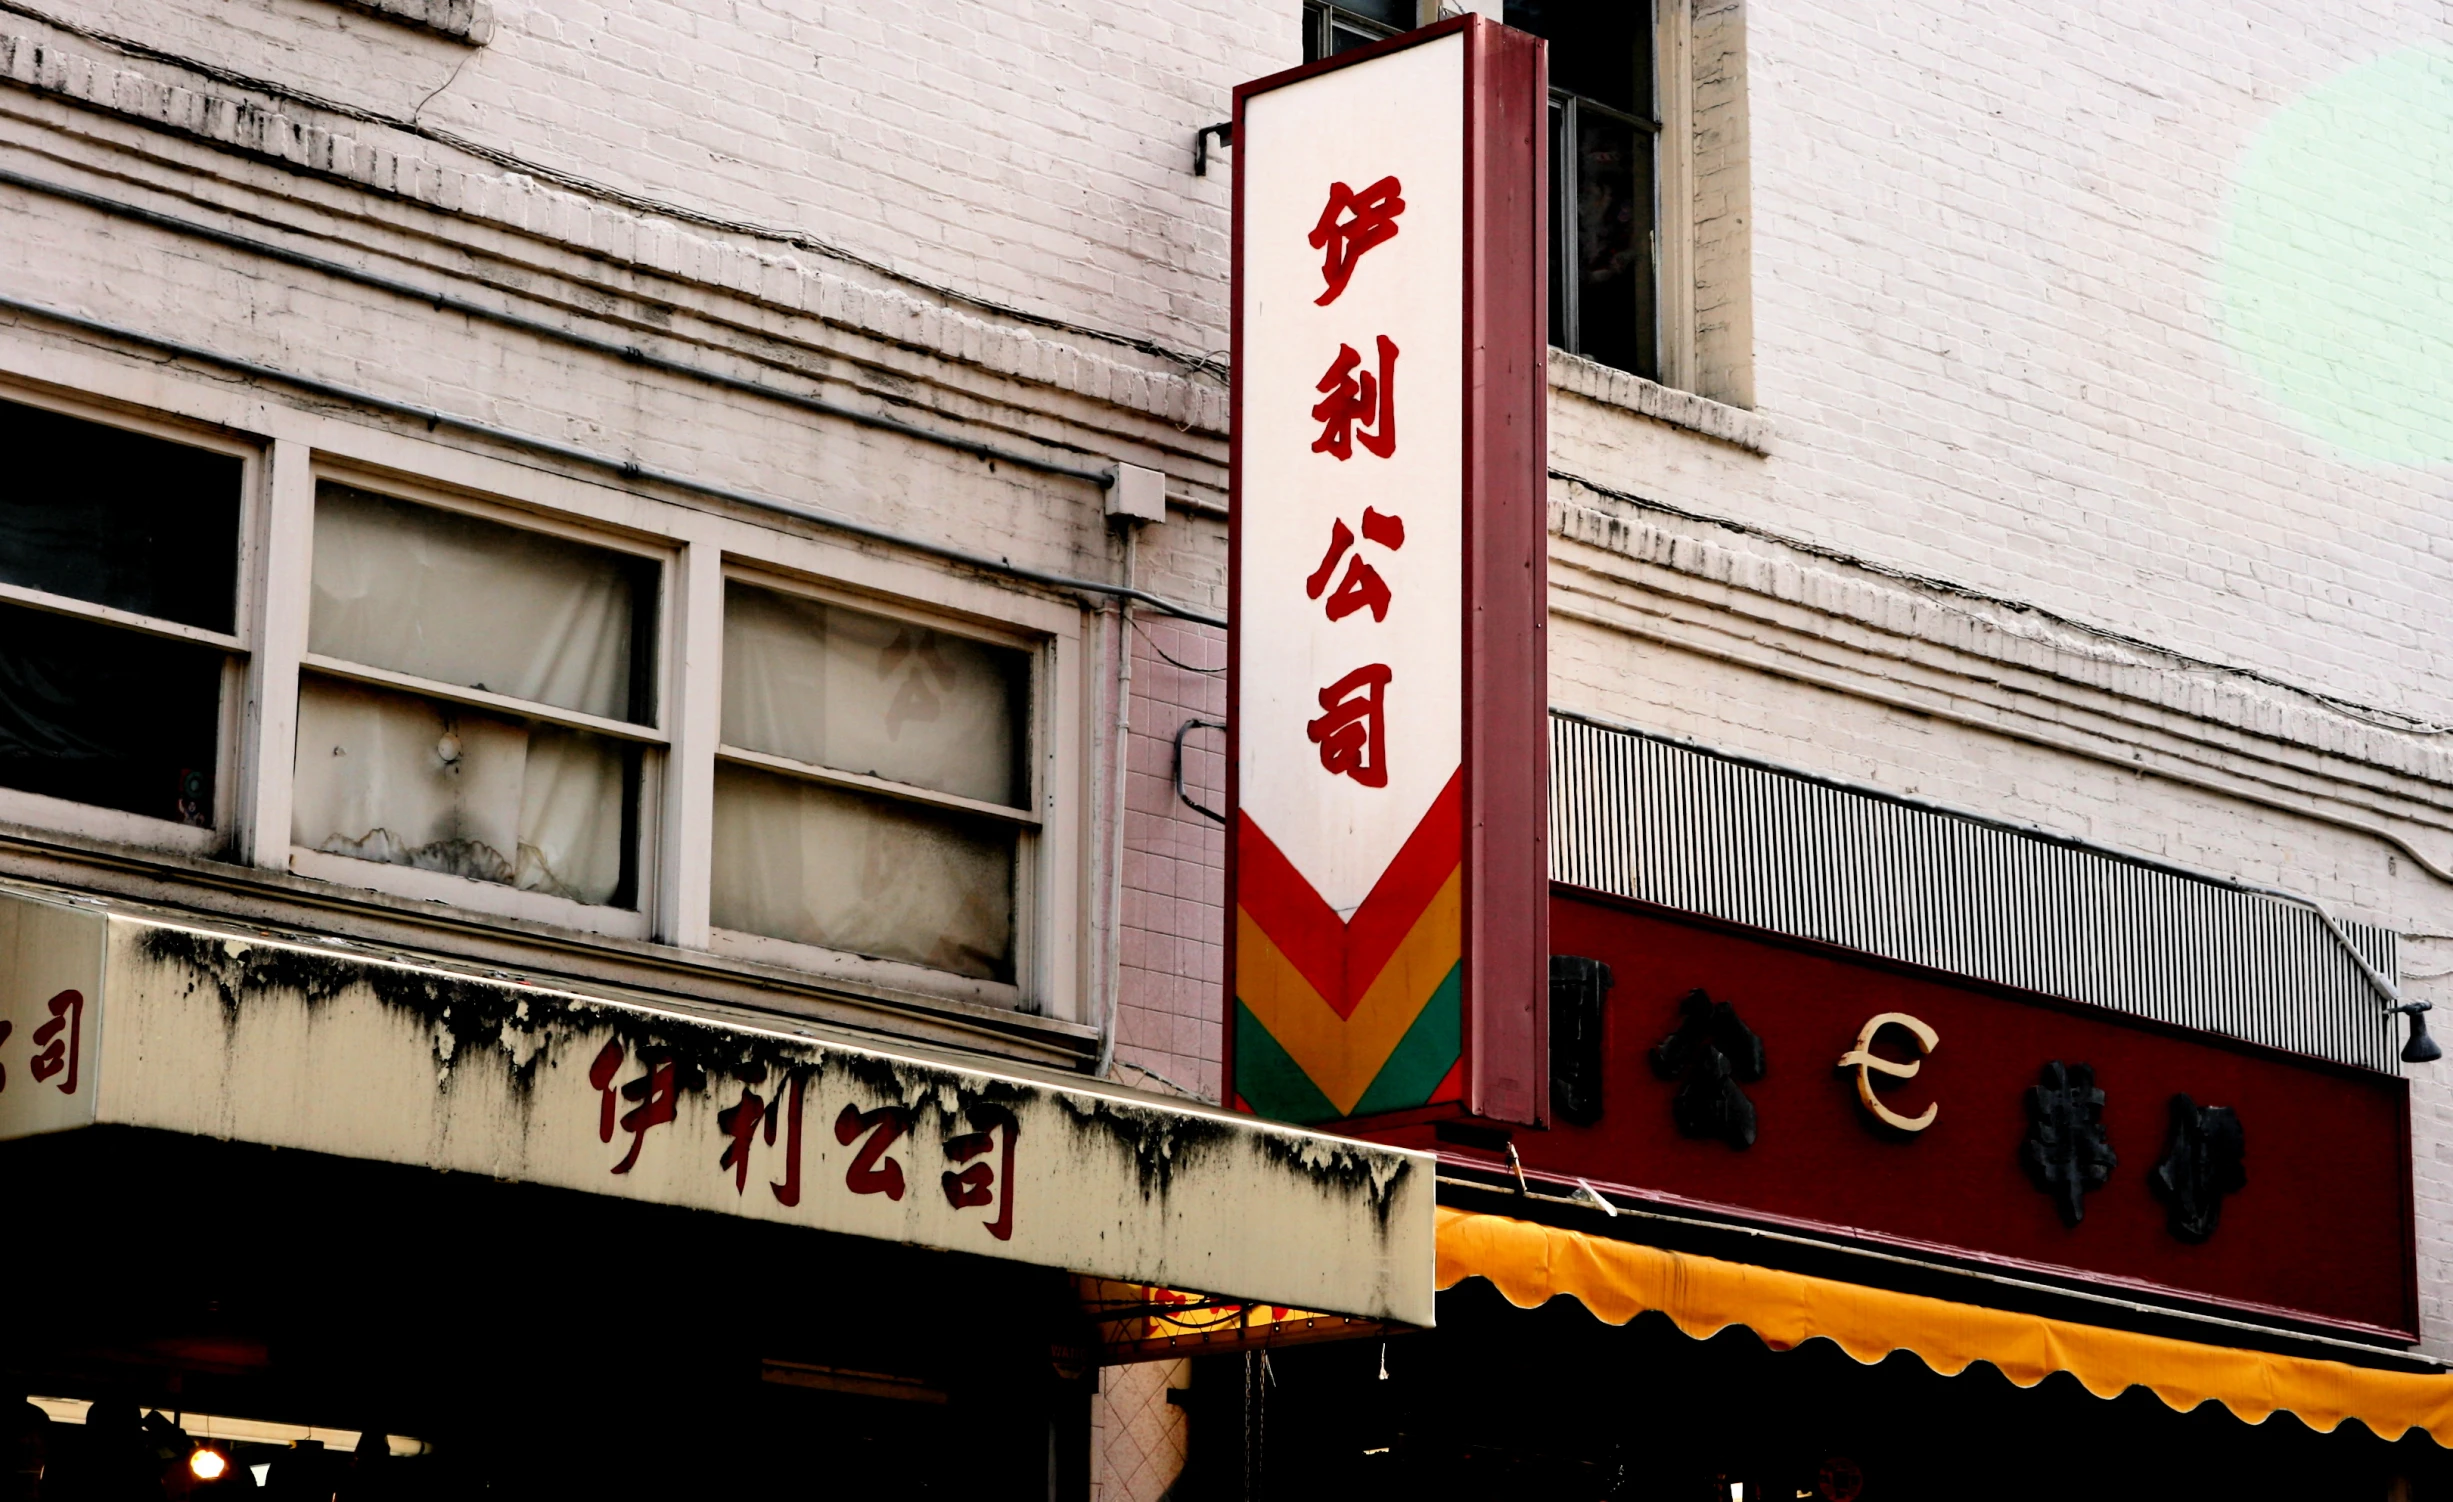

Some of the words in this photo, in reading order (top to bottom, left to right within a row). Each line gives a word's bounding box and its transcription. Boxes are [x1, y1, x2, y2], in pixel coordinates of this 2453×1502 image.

[1306, 175, 1406, 788] 伊利公司
[0, 989, 84, 1095] 司
[589, 1036, 1020, 1241] 伊利公司
